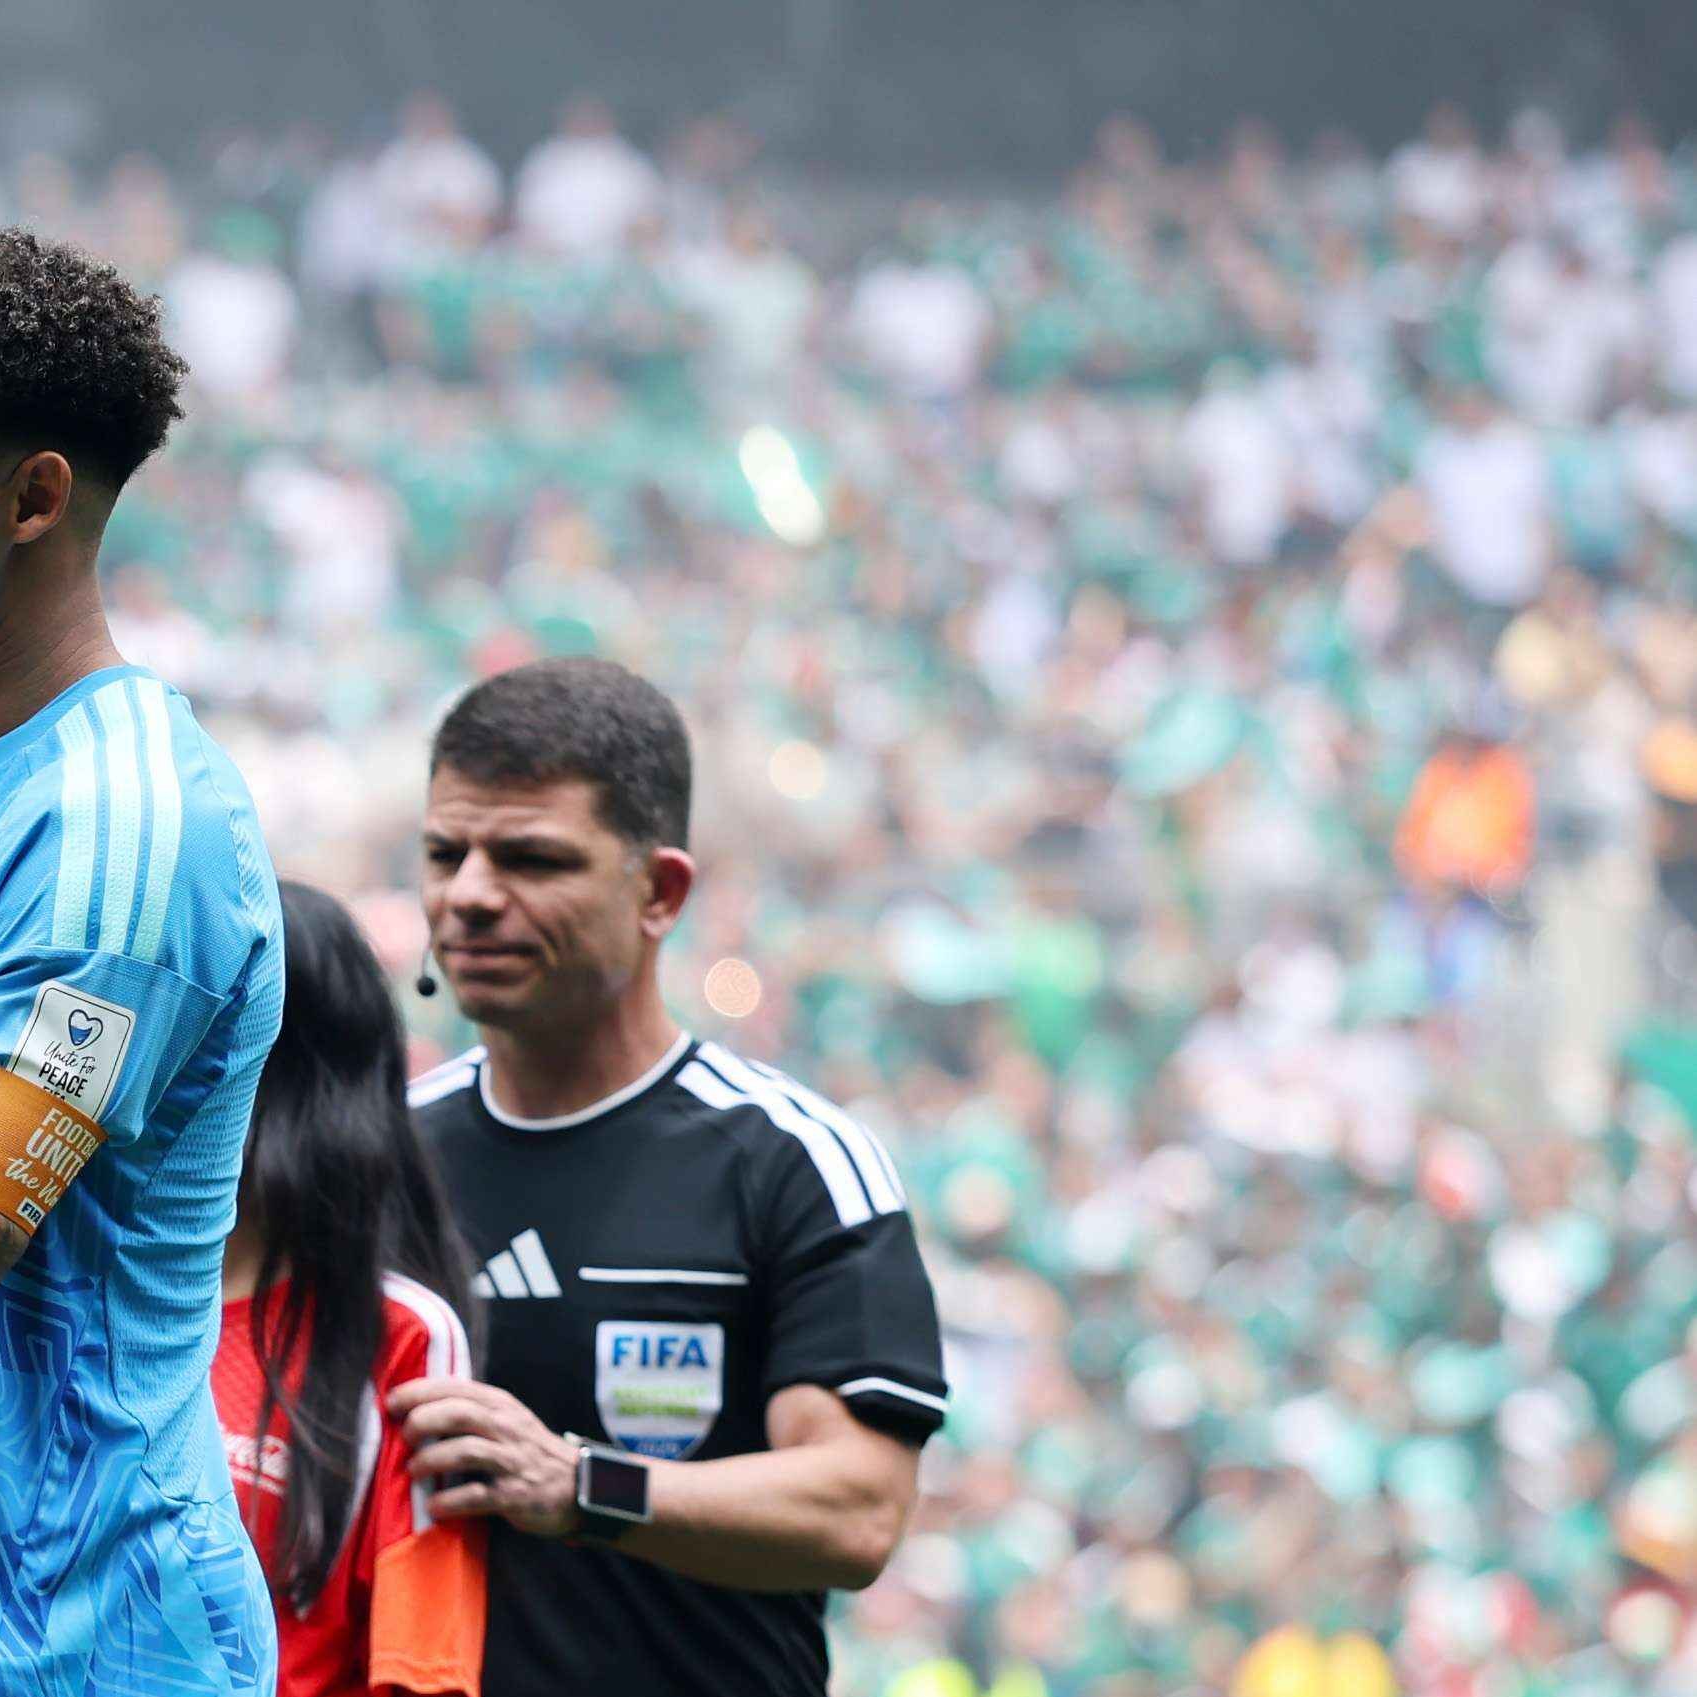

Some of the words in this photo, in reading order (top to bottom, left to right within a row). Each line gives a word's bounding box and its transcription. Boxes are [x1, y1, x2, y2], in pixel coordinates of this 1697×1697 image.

[44, 1040, 79, 1067] Unite
[79, 1055, 96, 1075] For
[39, 1062, 88, 1098] PEACE
[5, 1156, 40, 1189] the
[612, 1335, 709, 1368] FIFA
